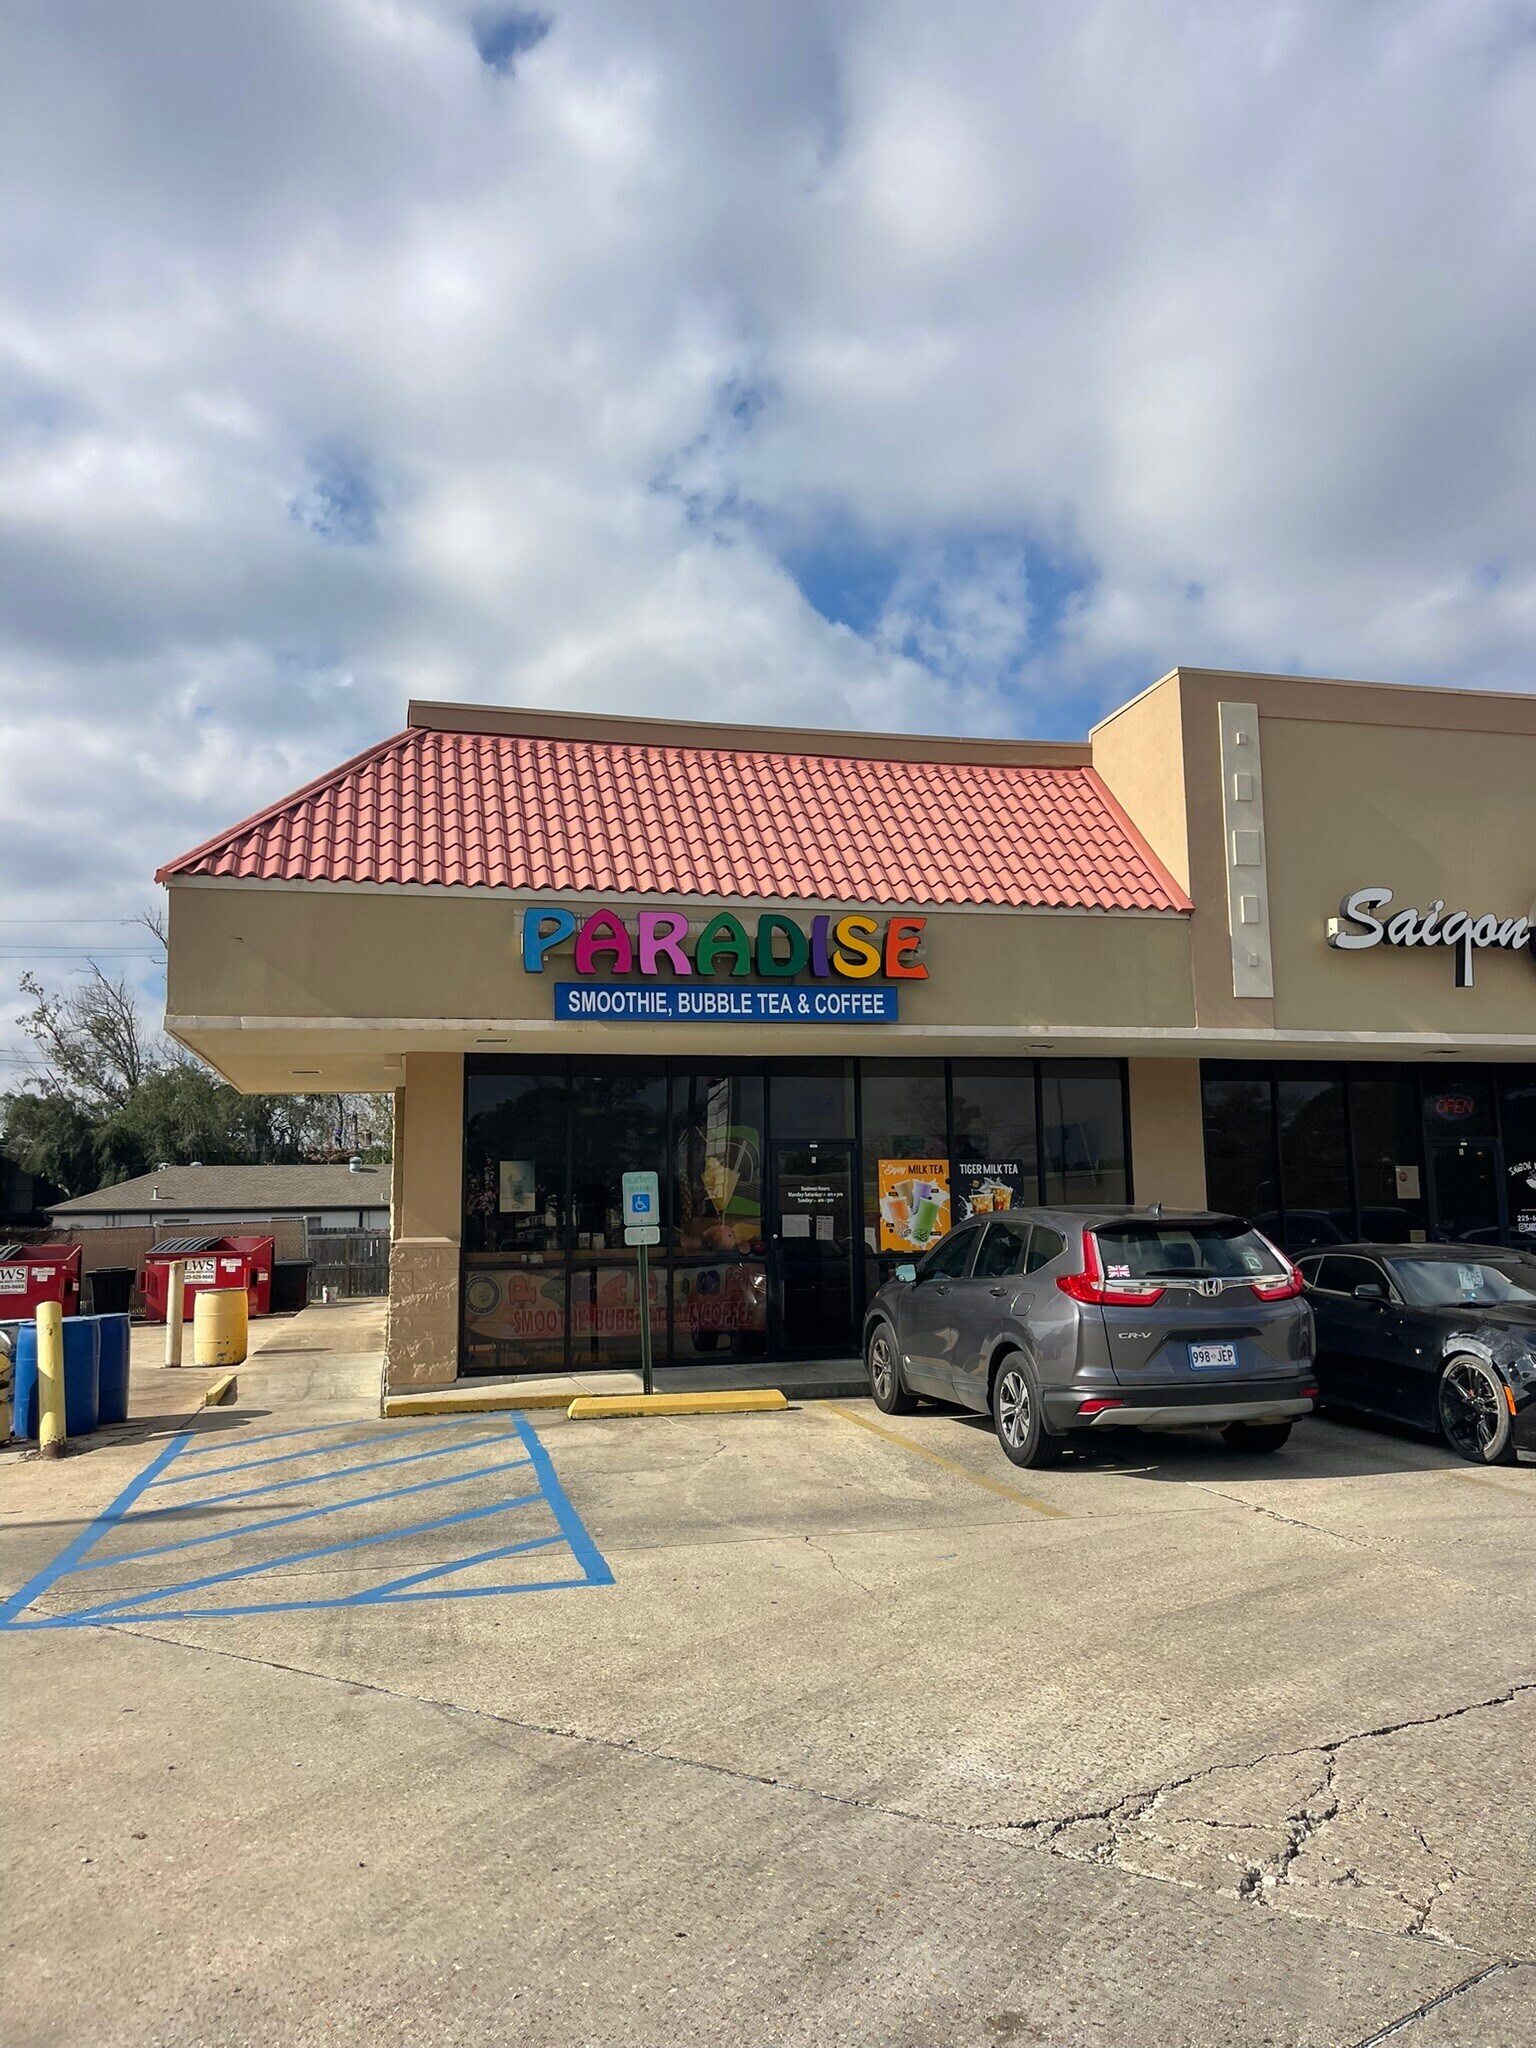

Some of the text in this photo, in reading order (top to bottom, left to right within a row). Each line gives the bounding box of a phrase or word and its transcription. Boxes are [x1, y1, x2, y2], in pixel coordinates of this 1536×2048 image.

[523, 907, 930, 980] PARADISE
[1333, 887, 1531, 987] Saigon
[568, 991, 885, 1017] SMOOTHIE, BUBBLE TEA & COFFEE
[884, 1162, 944, 1175] Enjoy MILK TEA
[960, 1163, 1018, 1174] TIGER MILK TEA
[184, 1259, 214, 1271] LWS
[513, 1309, 587, 1334] SMOOTIE
[1118, 1331, 1152, 1339] CR-V
[1193, 1349, 1233, 1363] 998 JEP
